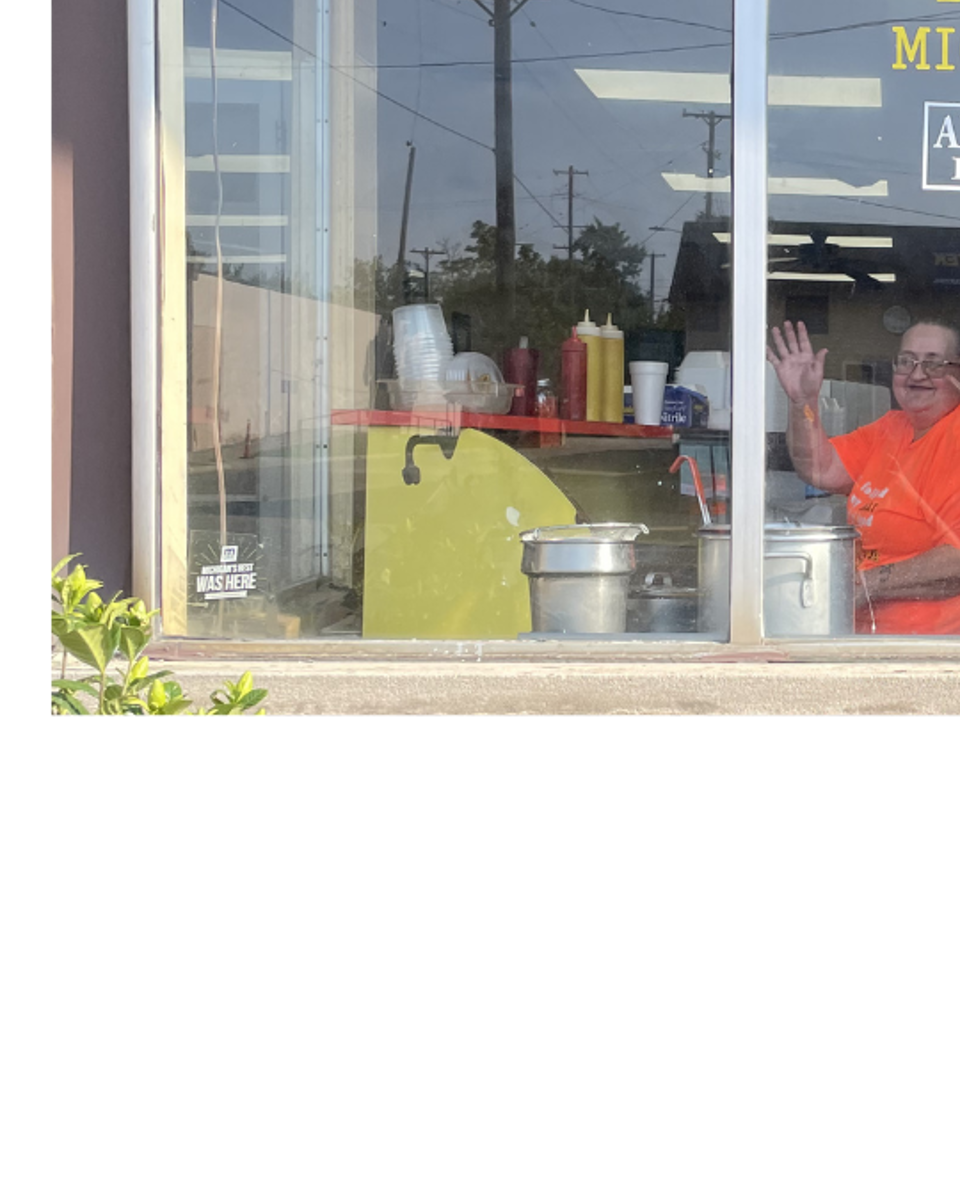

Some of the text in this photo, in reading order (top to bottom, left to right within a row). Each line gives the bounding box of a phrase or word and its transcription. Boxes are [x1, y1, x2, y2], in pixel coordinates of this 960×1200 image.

[661, 411, 687, 423] itrile
[197, 572, 257, 593] WAS HERE
